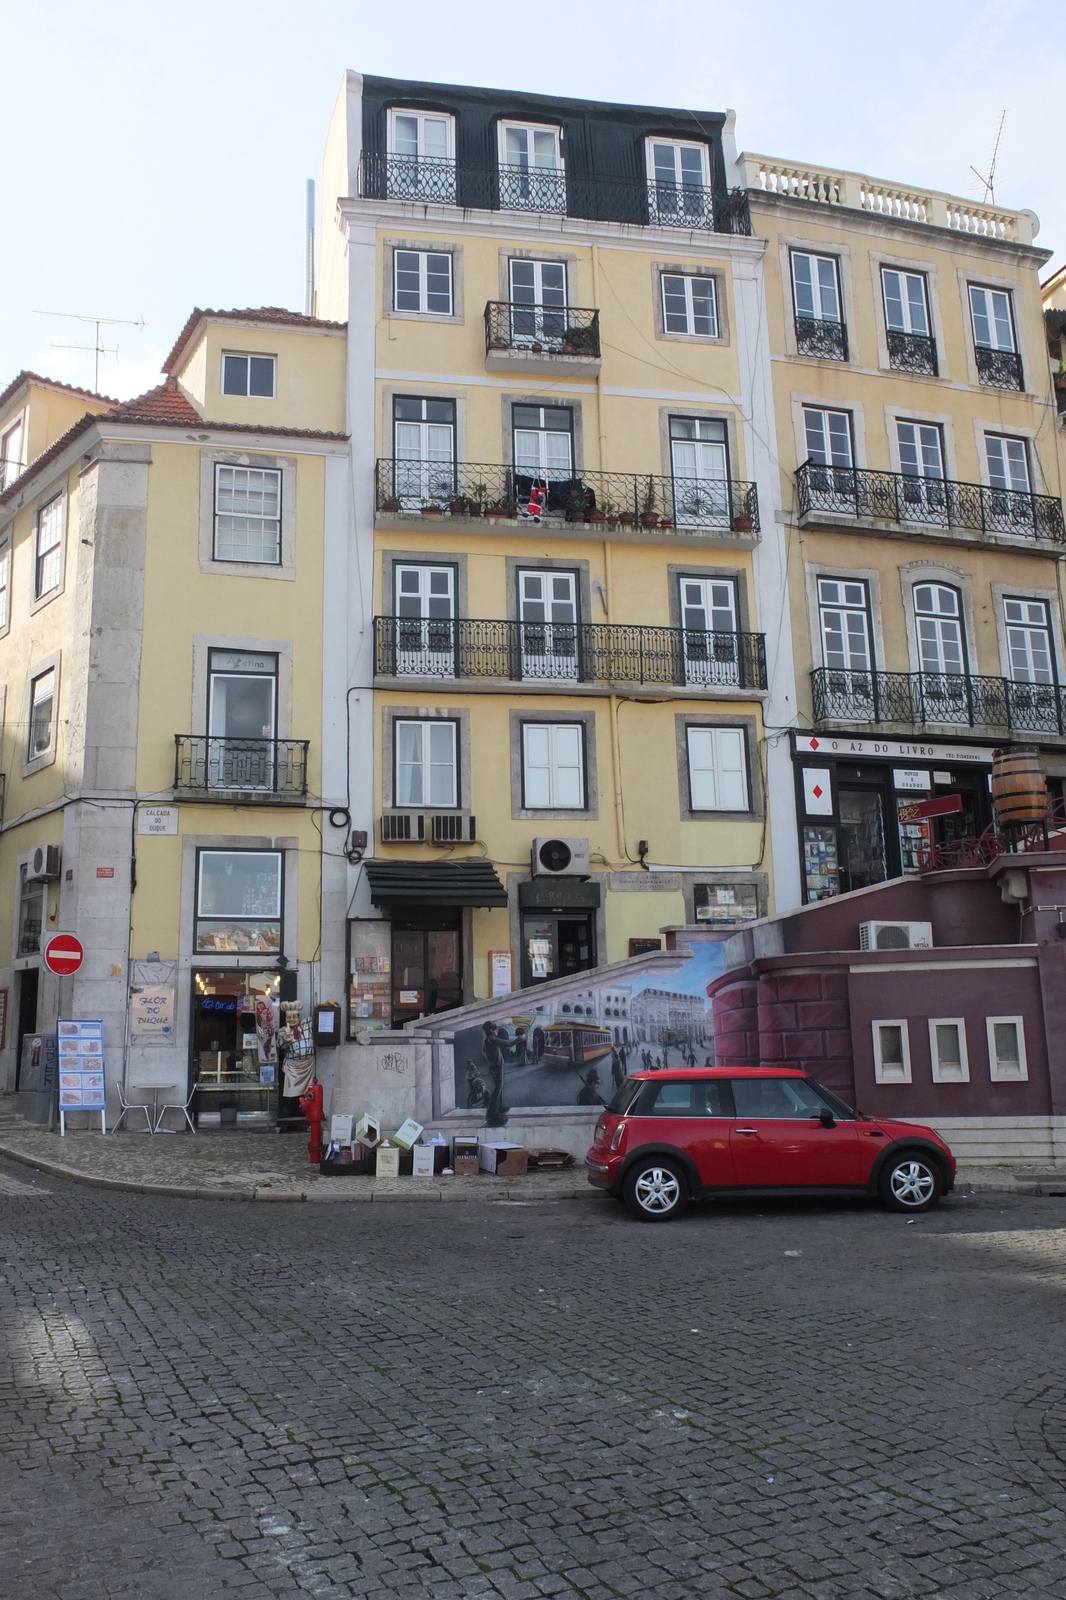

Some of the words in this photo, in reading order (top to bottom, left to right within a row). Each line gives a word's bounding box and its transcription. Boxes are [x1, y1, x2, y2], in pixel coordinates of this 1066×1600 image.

[832, 741, 838, 750] O
[850, 742, 863, 751] AZ
[874, 744, 888, 752] DO
[899, 745, 934, 755] LIVRO
[145, 809, 170, 817] CALÇADA
[137, 1017, 168, 1025] DUQUE
